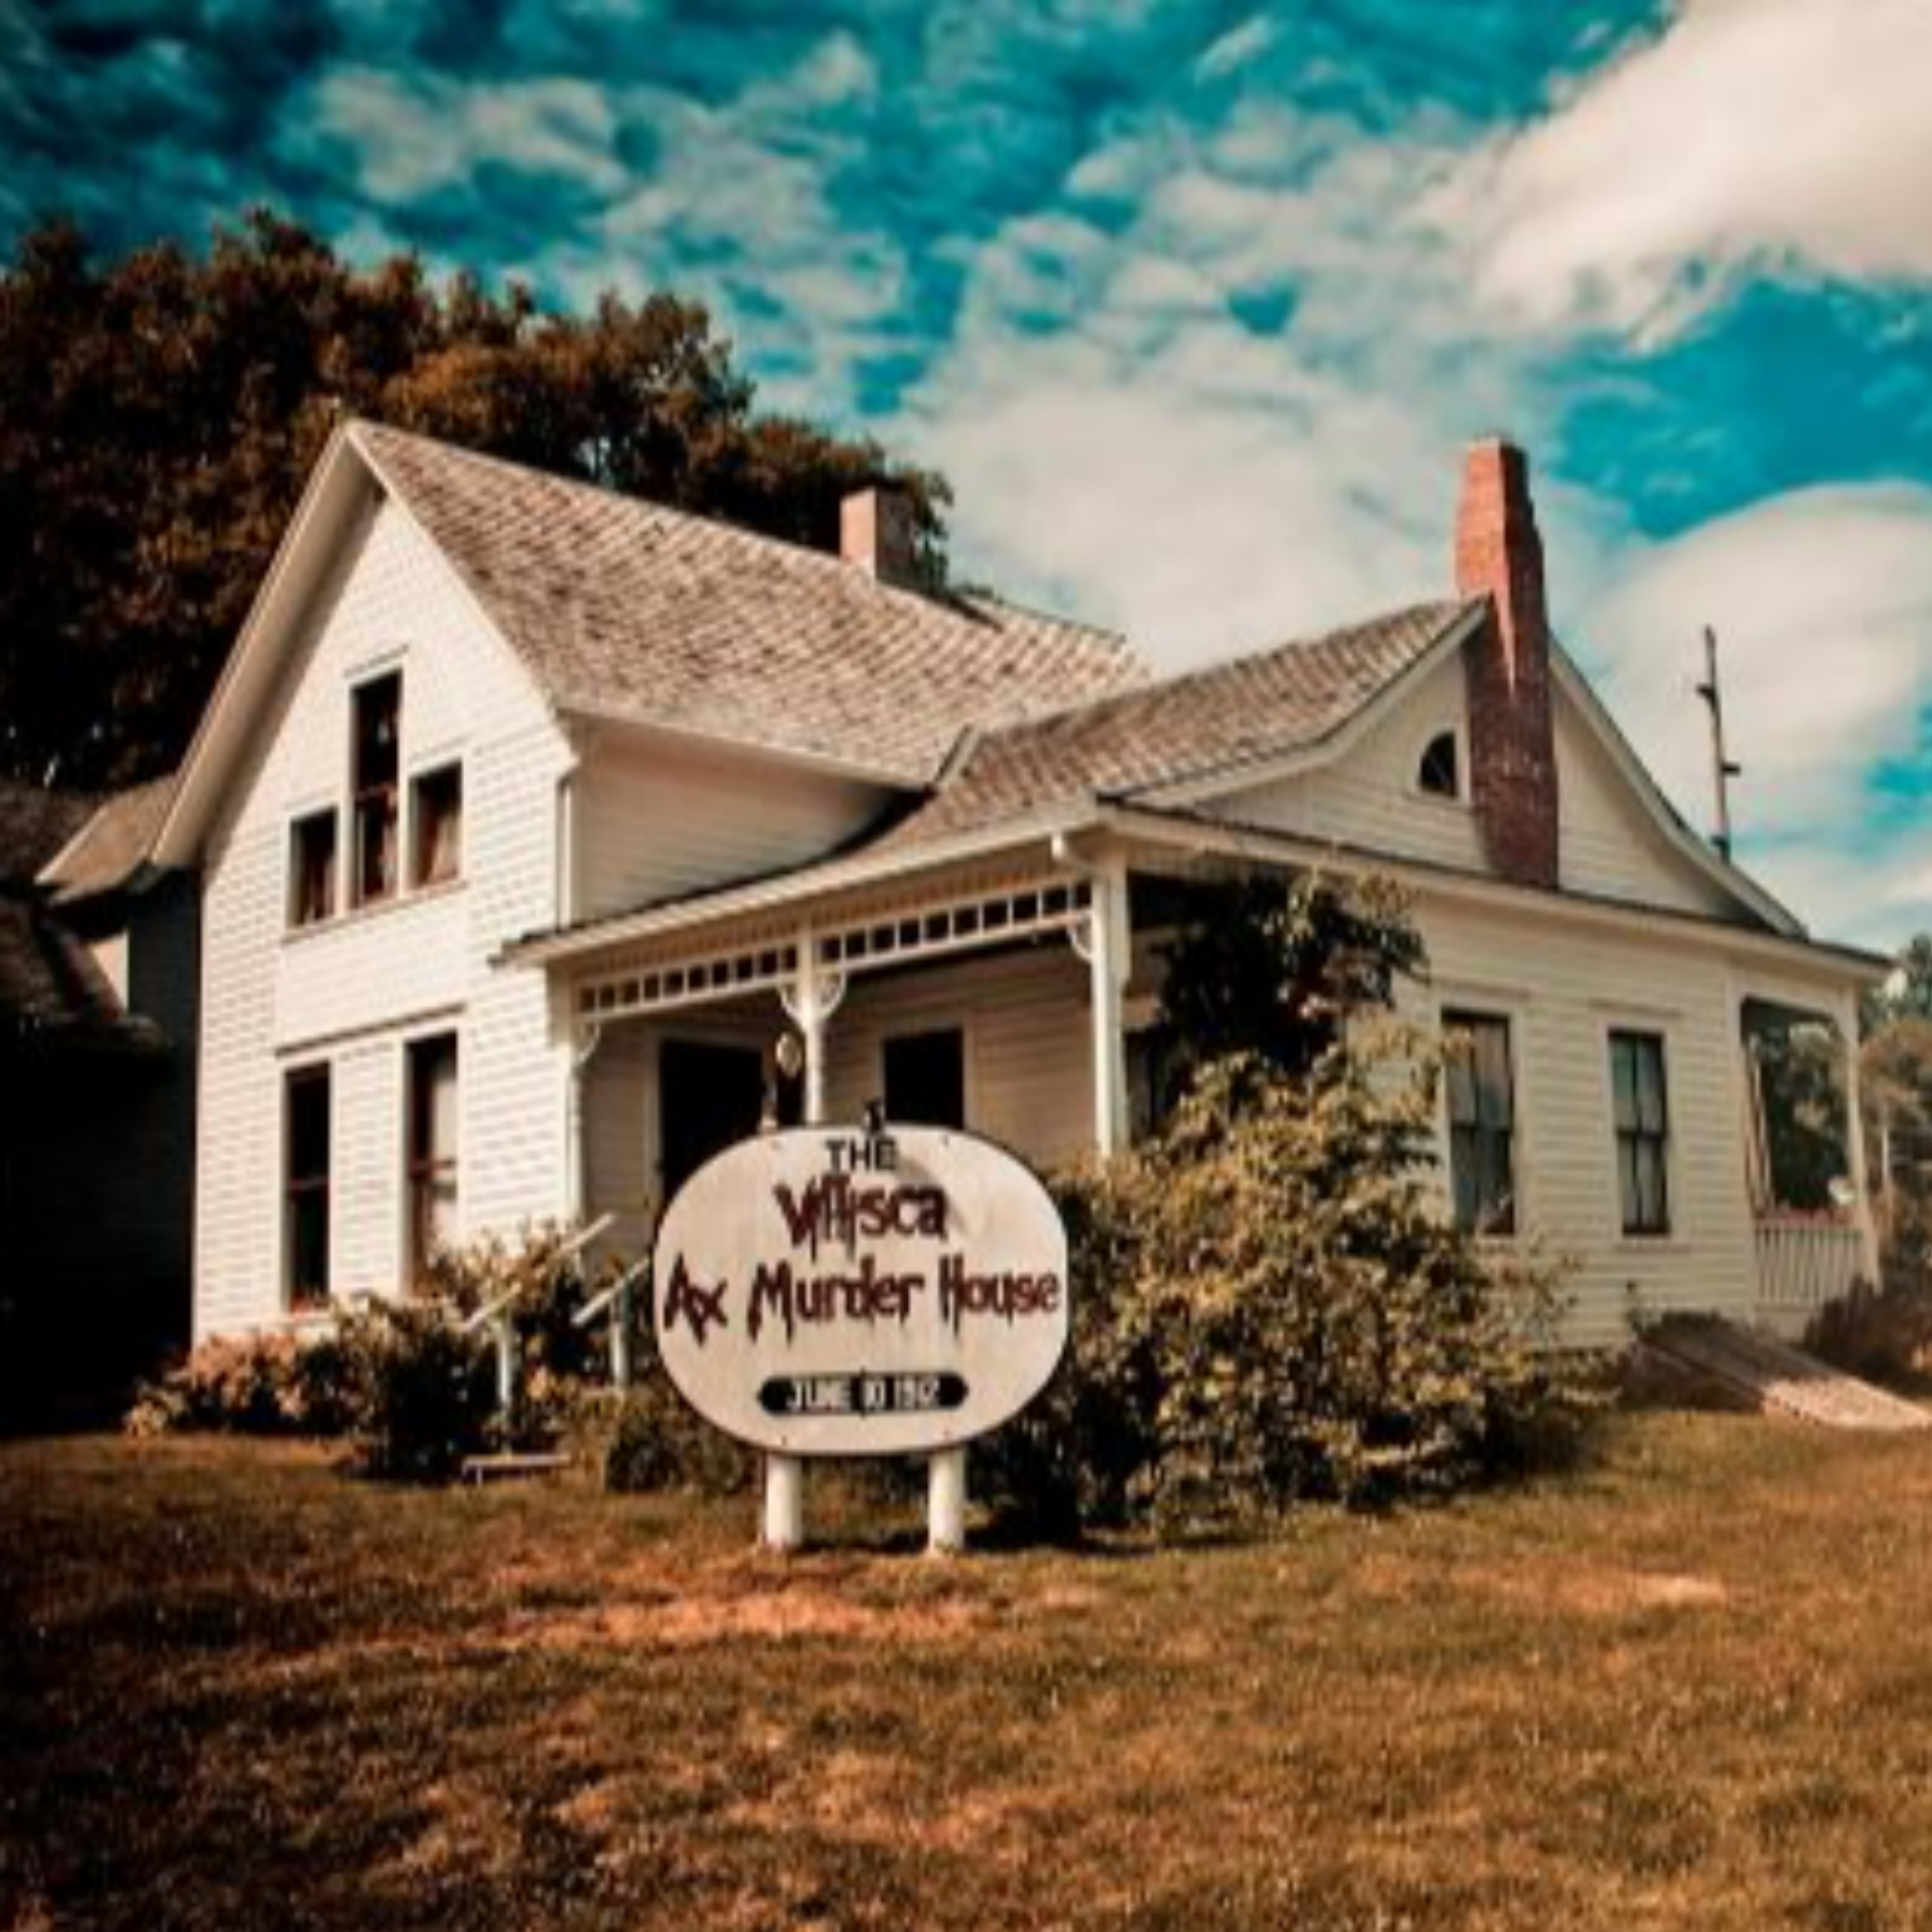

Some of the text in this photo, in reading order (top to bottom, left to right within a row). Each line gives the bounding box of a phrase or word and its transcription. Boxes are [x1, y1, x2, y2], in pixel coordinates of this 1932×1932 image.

[824, 1139, 896, 1171] THE
[663, 1253, 1060, 1345] Ax Murder House
